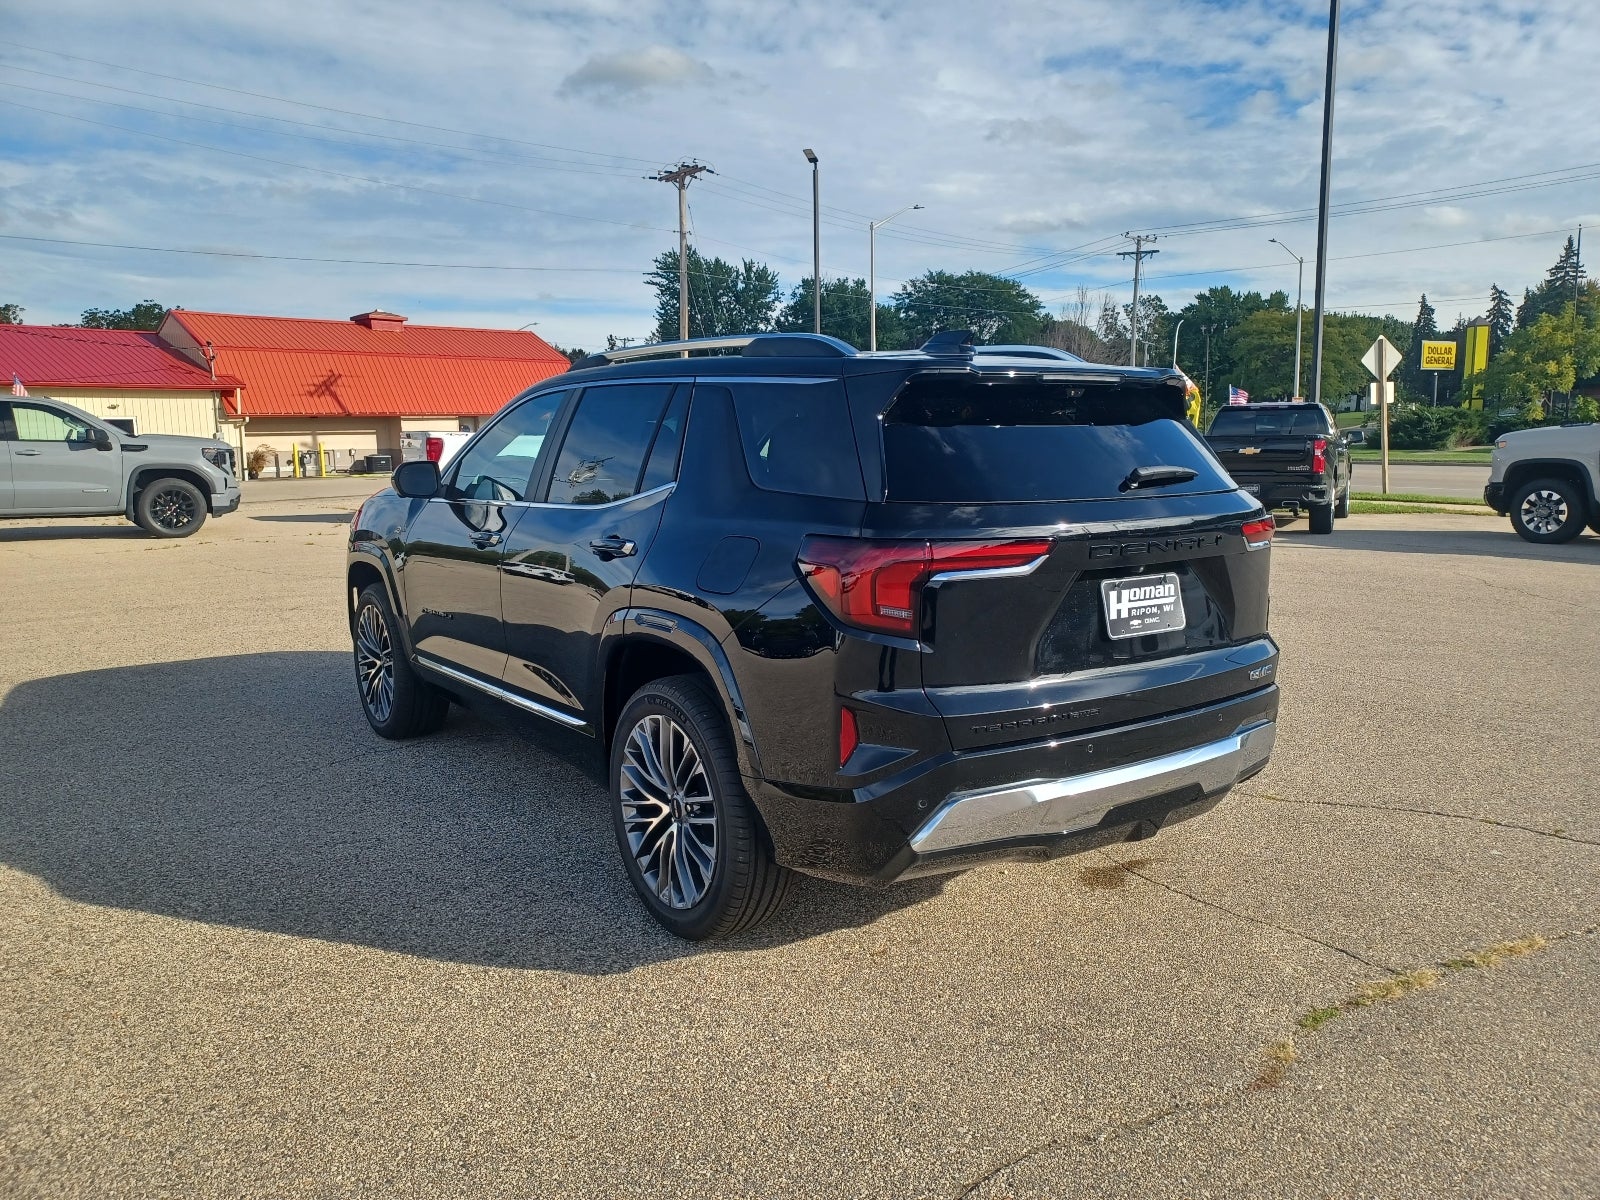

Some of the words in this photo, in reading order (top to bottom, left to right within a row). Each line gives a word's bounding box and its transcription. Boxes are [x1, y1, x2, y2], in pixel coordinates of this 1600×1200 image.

[1427, 346, 1453, 356] DOLLAR
[1425, 355, 1454, 365] GENERAL
[1088, 533, 1223, 560] DENALI
[1108, 583, 1177, 620] Homan
[1131, 606, 1160, 617] RIPON,
[1162, 604, 1174, 612] WI
